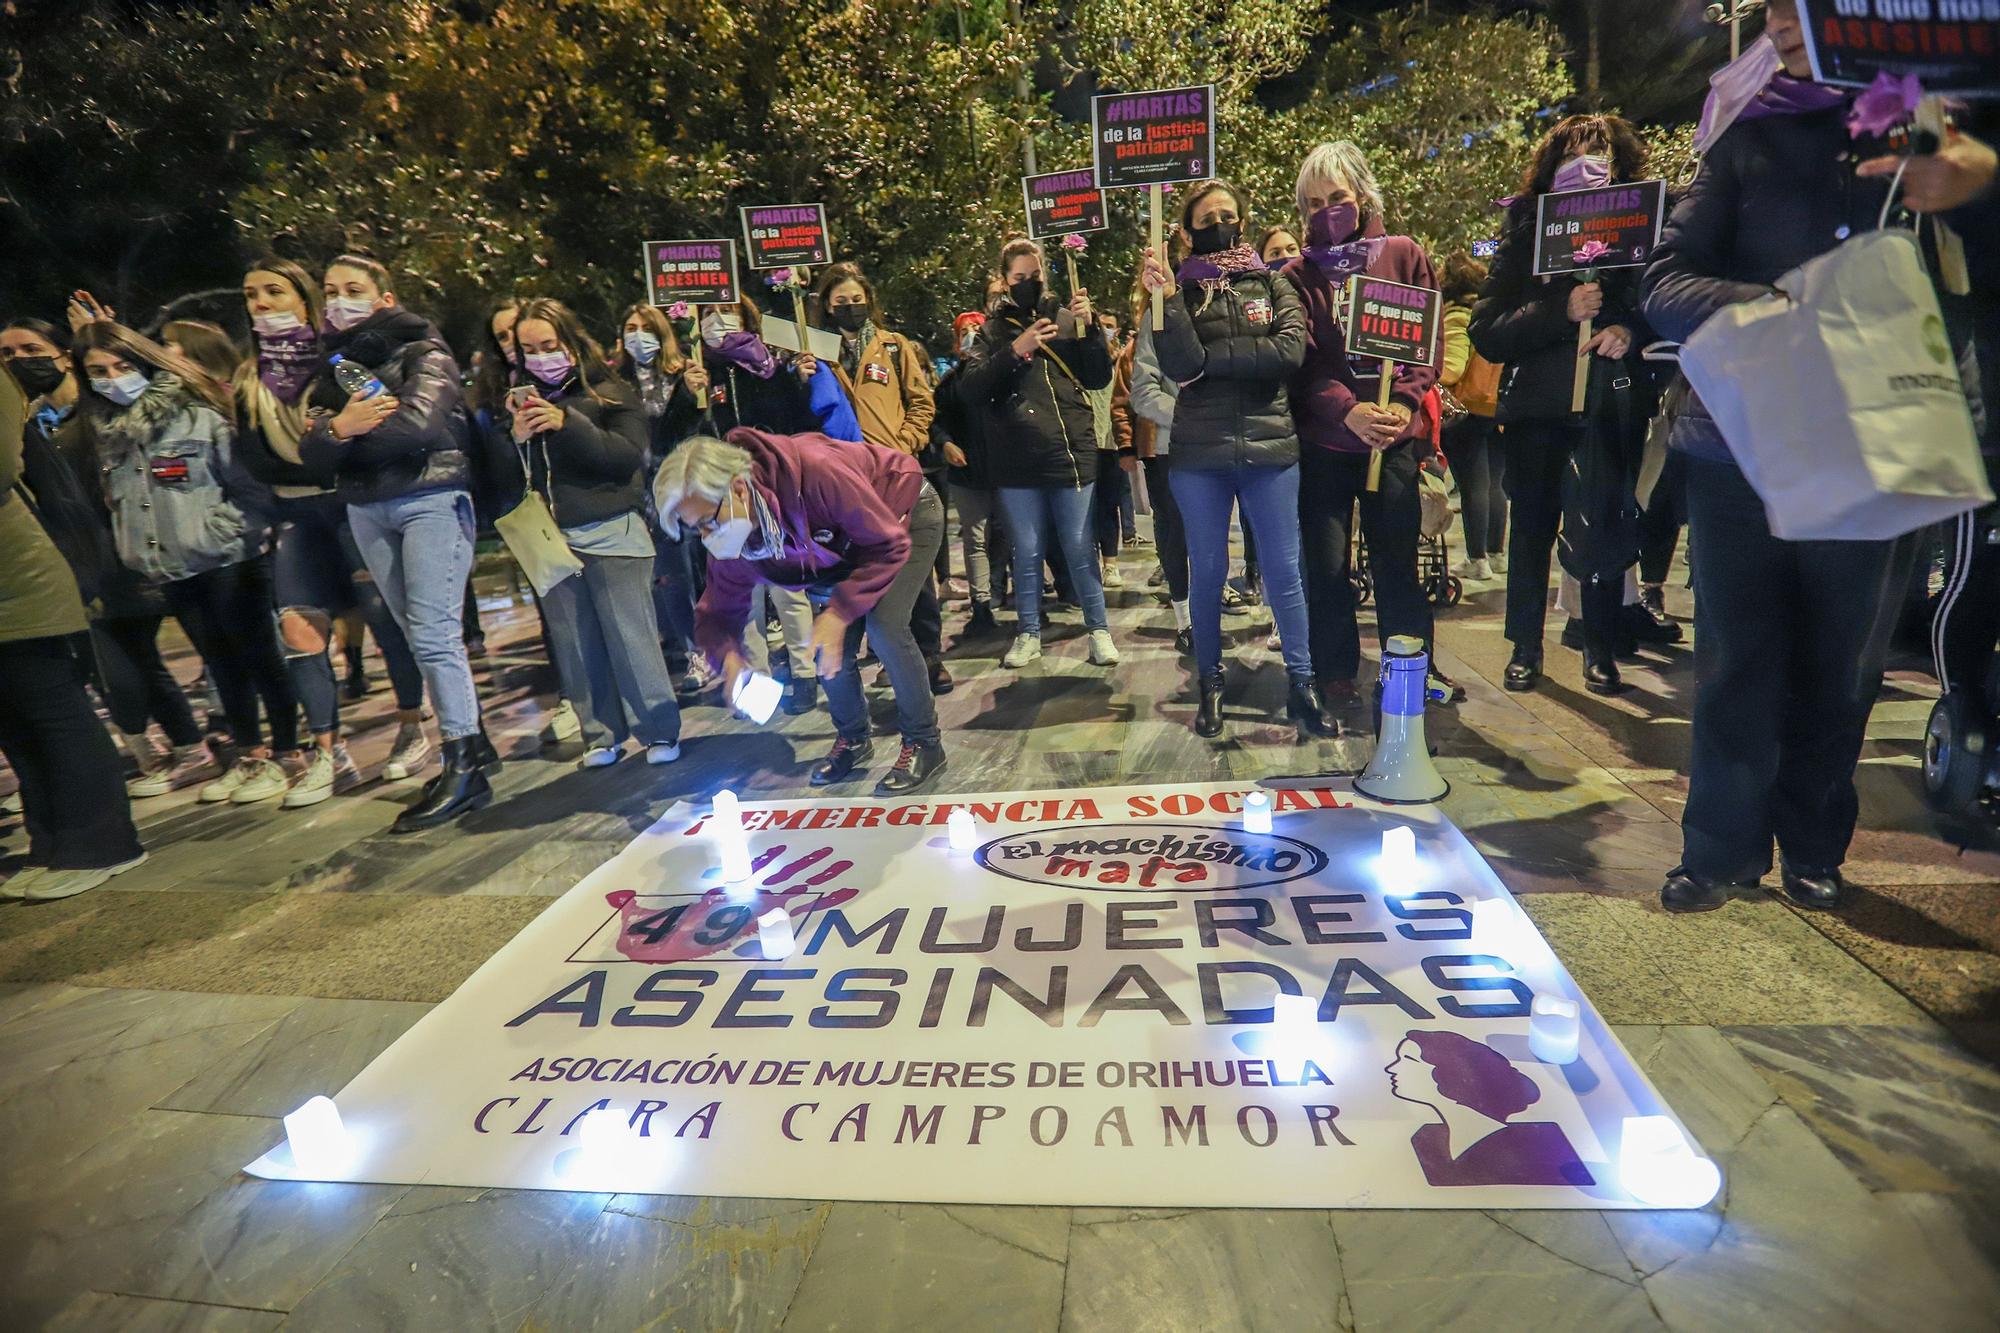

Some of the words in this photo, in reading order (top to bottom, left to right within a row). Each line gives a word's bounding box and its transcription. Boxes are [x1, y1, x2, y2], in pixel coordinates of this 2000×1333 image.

[1105, 92, 1202, 122] #HARTAS
[1103, 127, 1125, 144] de
[1127, 126, 1142, 142] la
[1146, 120, 1207, 141] justicia
[1115, 137, 1194, 159] patriarcal
[1034, 172, 1092, 194] #HARTAS
[1030, 198, 1044, 211] de
[1045, 197, 1055, 208] la
[1056, 191, 1100, 207] violencia
[1051, 206, 1082, 219] sexual
[1555, 189, 1642, 217] #HARTAS
[752, 208, 818, 225] #HARTAS
[1545, 223, 1563, 237] de
[1566, 221, 1580, 235] la
[1583, 212, 1648, 232] violencia
[751, 228, 767, 239] de
[767, 227, 779, 238] la
[780, 225, 822, 239] justicia
[761, 238, 815, 250] patriarcal
[657, 245, 721, 260] #HARTAS
[656, 272, 729, 286] ASESINEN
[662, 262, 677, 272] de
[677, 262, 699, 274] que
[700, 261, 721, 271] nos
[1362, 282, 1428, 309] #HARTAS
[1364, 301, 1379, 315] de
[1380, 305, 1401, 319] que
[1402, 309, 1423, 323] nos
[1361, 314, 1423, 342] VIOLEN
[1127, 787, 1354, 818] SOCAL
[1002, 840, 1044, 860] El
[1046, 834, 1302, 873] machismo
[1044, 856, 1208, 888] mata
[626, 903, 753, 946] 49
[803, 891, 1474, 956] MUJERES
[504, 954, 1535, 1029] ASESINADAS
[509, 1053, 748, 1086] ASOCIACIÓN
[749, 1060, 810, 1086] DE
[813, 1060, 1016, 1088] MUJERES
[1027, 1061, 1085, 1088] DE
[1098, 1059, 1335, 1088] ORIHUELA
[781, 1102, 1358, 1147] CAMPOAMOR
